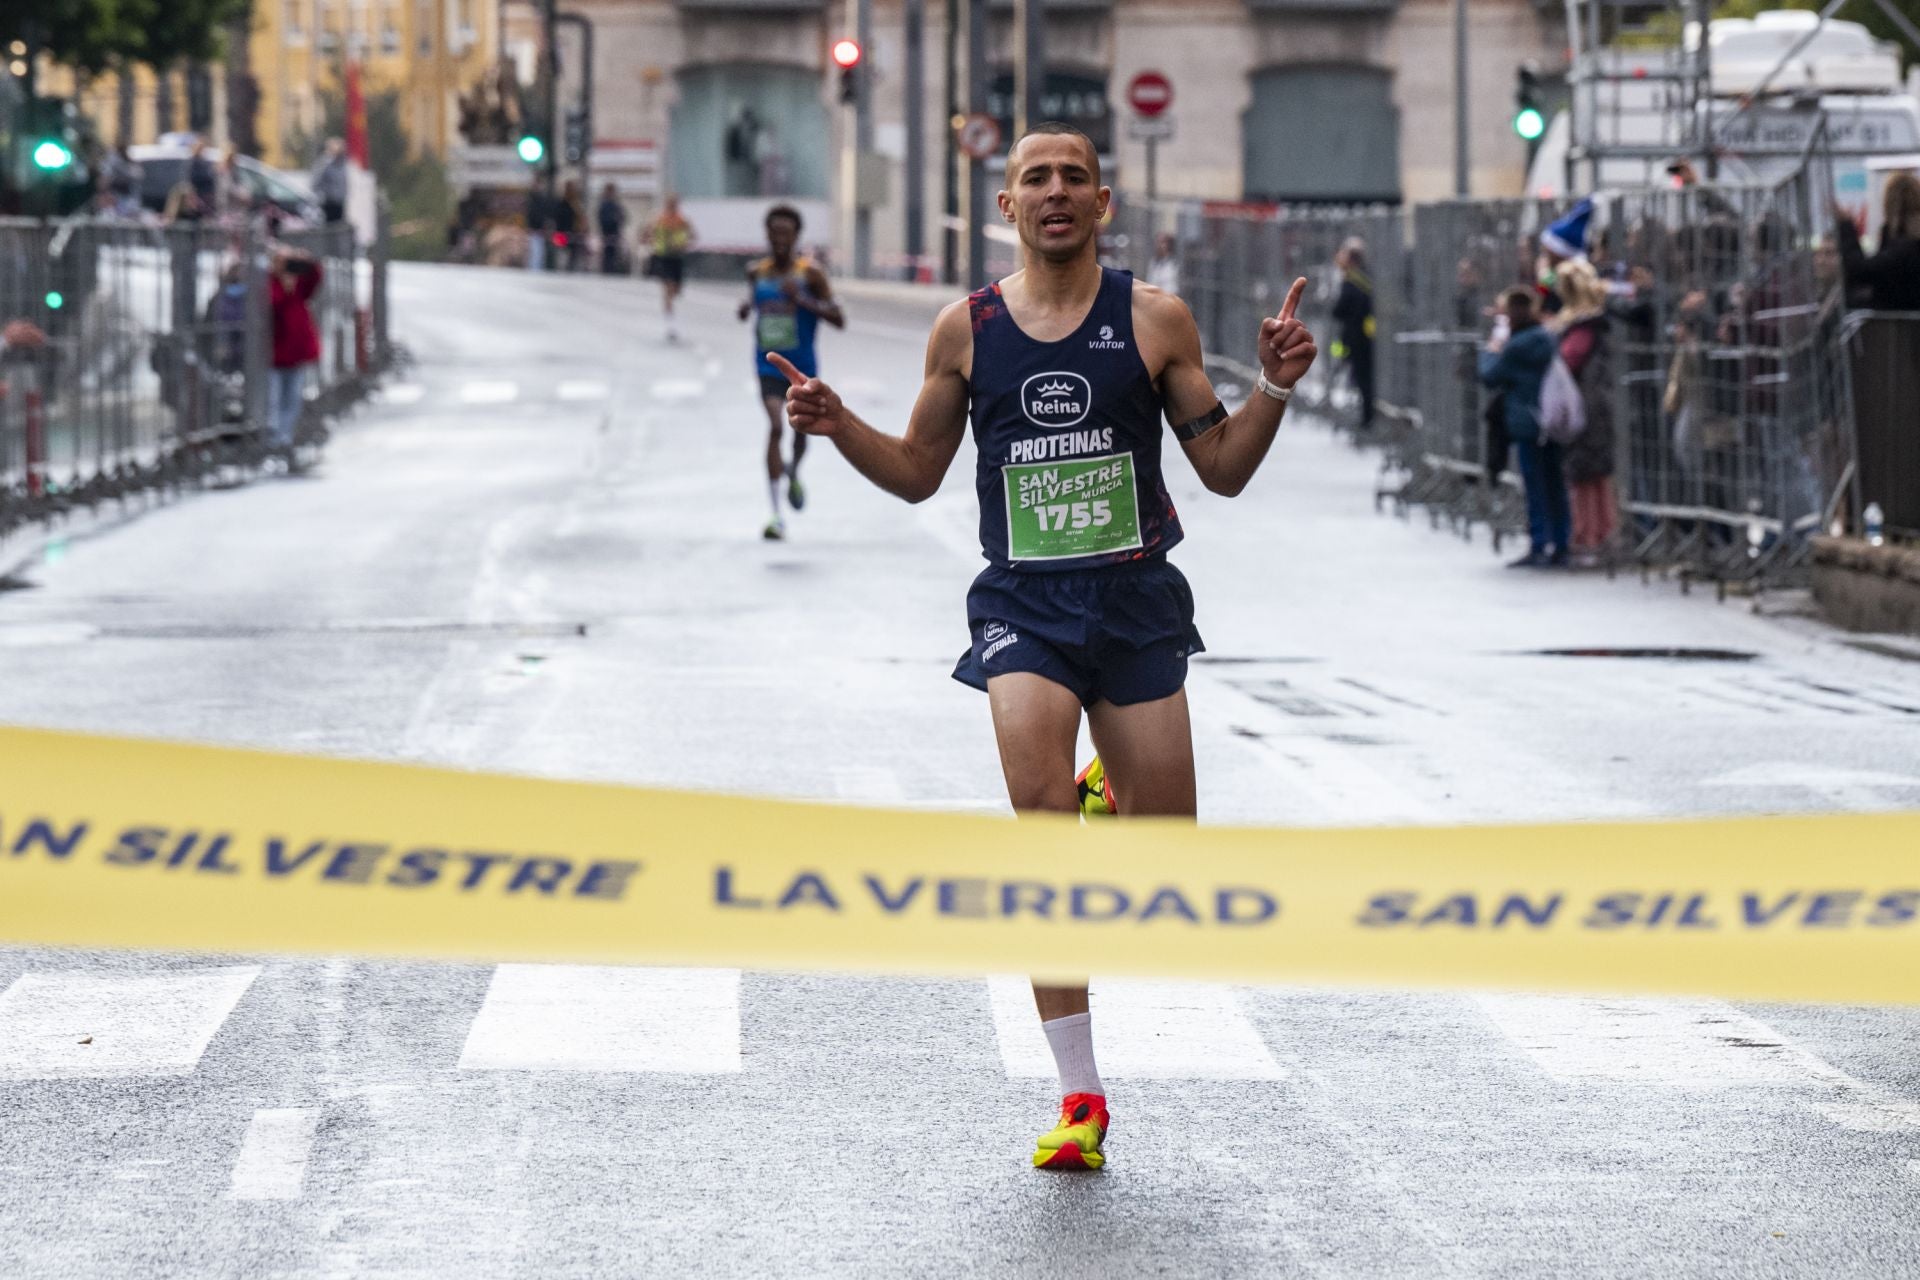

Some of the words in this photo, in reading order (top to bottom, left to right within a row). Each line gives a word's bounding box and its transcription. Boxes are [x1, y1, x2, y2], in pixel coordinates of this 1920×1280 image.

[1089, 341, 1125, 349] VIATOR
[1032, 399, 1081, 415] Reina
[1010, 427, 1113, 463] PROTEINAS
[1019, 468, 1059, 492] SAN
[1020, 461, 1123, 509] SILVESTRE
[1081, 479, 1123, 500] MURCIA
[1033, 499, 1112, 531] 1755
[982, 633, 1018, 663] PROTEINAS
[103, 826, 640, 902] SILVESTRE
[713, 866, 843, 912] LA
[863, 874, 1281, 926] VERDAD
[1356, 891, 1564, 929] SAN
[1579, 891, 1920, 929] SILVES
